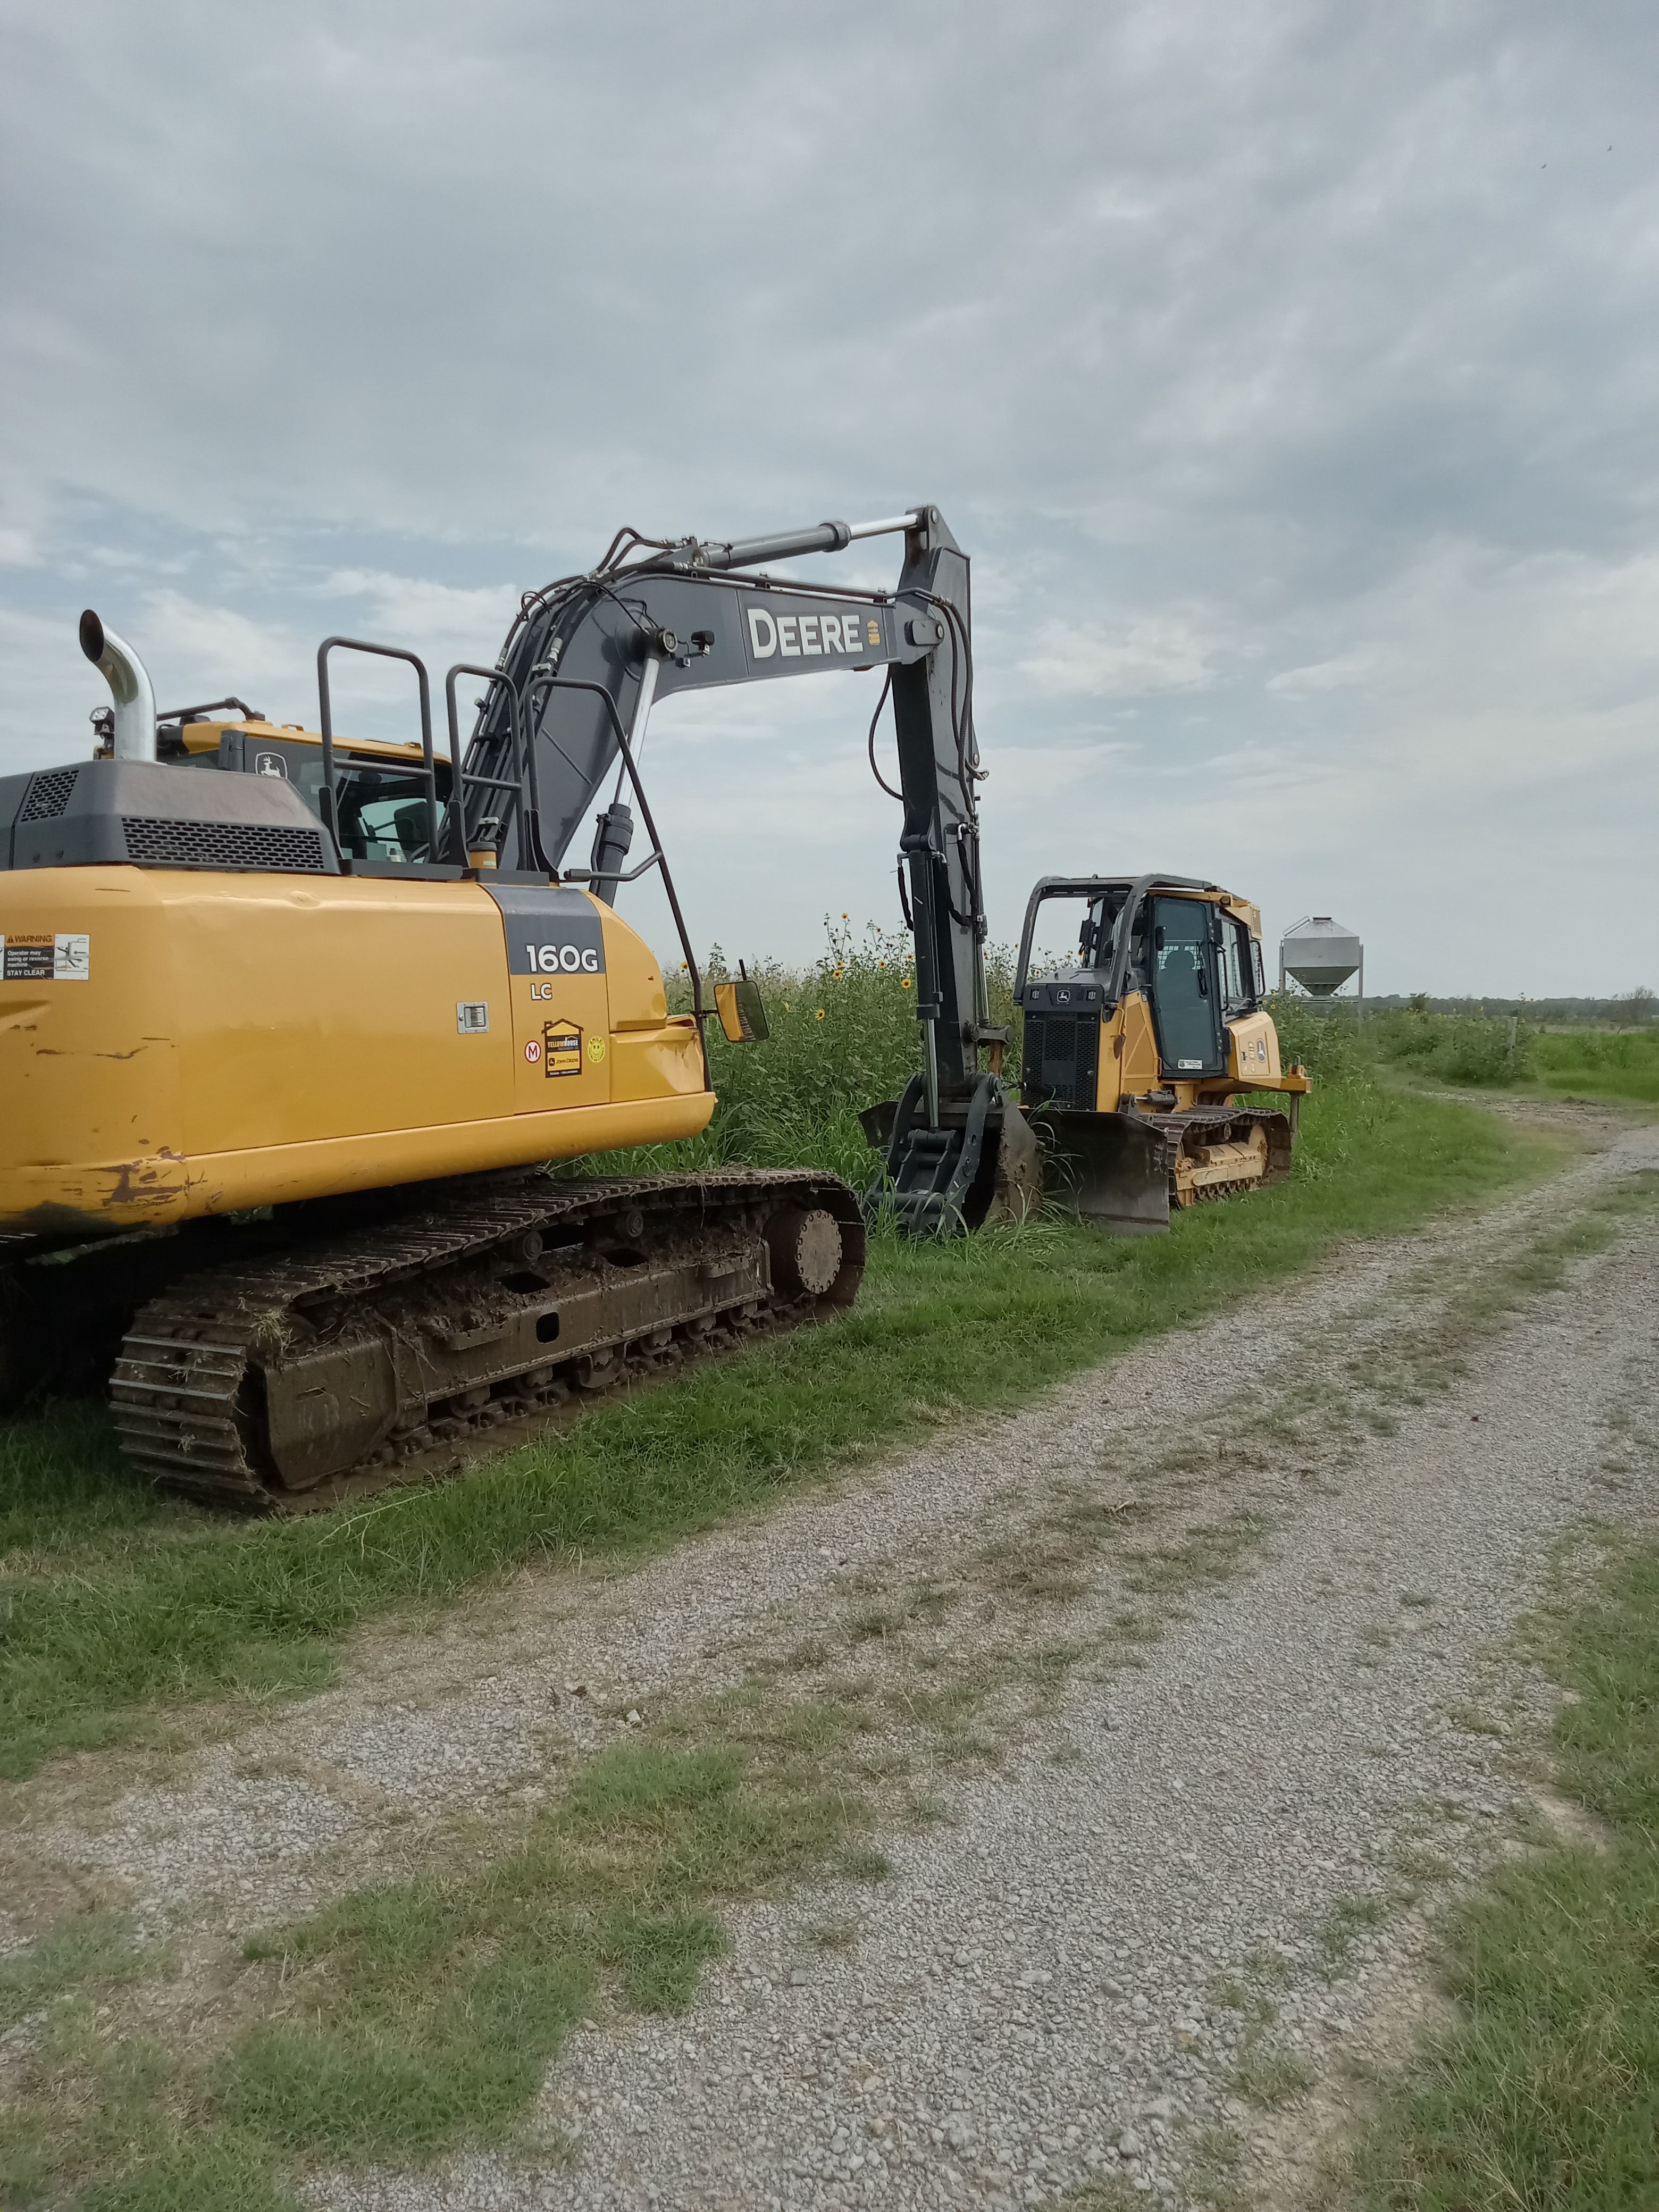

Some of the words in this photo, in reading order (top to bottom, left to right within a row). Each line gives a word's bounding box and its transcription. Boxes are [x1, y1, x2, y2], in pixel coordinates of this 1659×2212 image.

[747, 609, 864, 658] DEERE
[526, 945, 598, 972] 160G
[531, 984, 552, 1000] LC
[547, 1038, 579, 1048] YELLOWHOUSE
[529, 1045, 538, 1059] M
